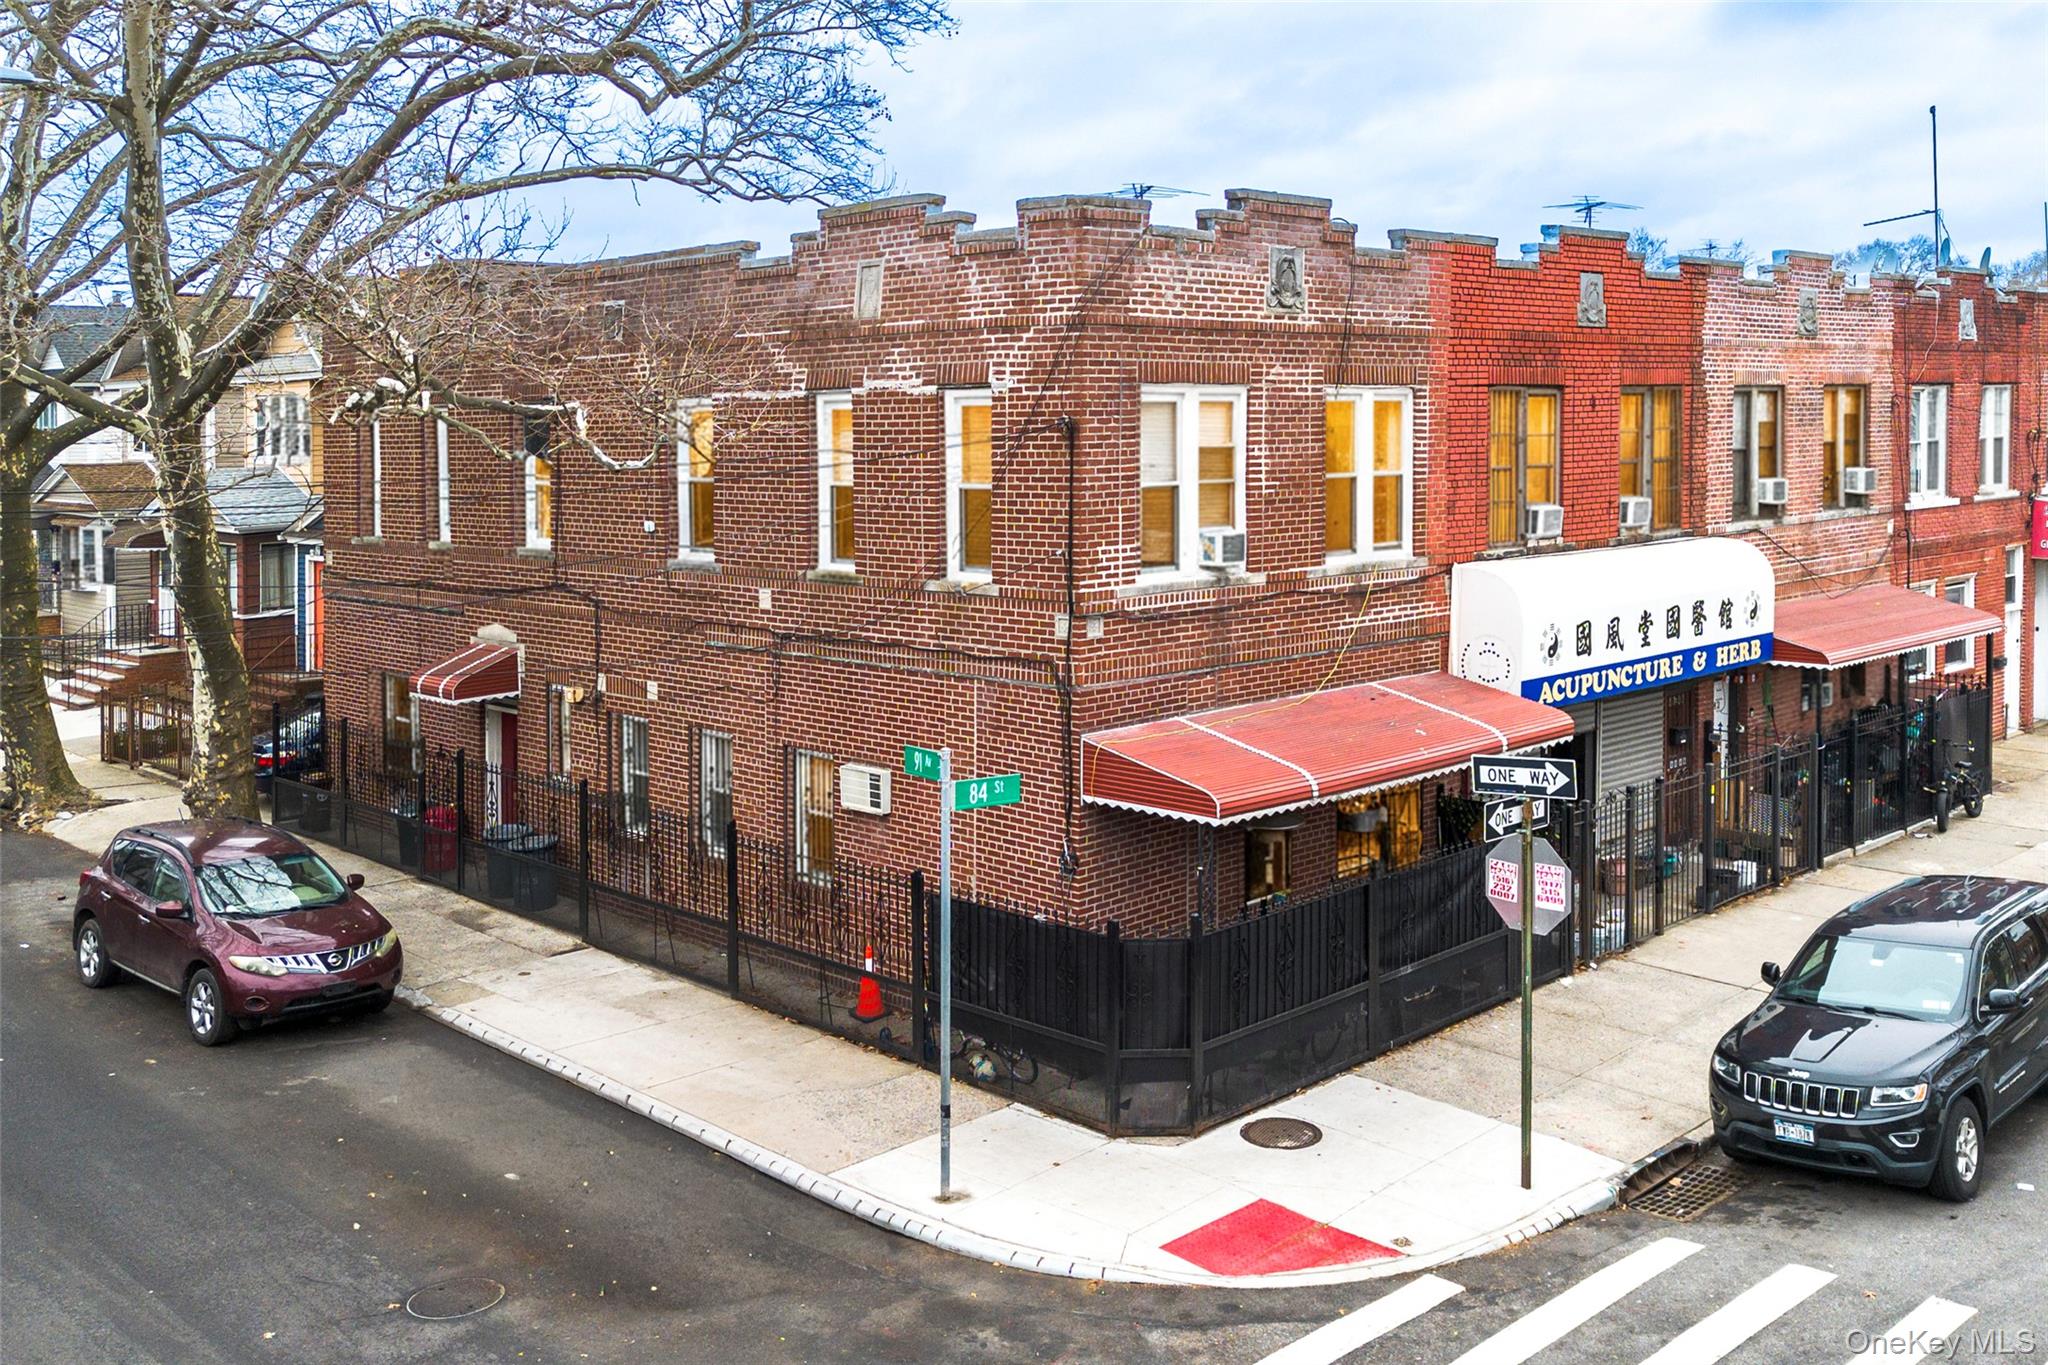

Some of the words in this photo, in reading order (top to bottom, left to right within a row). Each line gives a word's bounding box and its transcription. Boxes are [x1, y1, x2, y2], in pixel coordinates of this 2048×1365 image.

[1576, 598, 1734, 656] 國風堂國醫館
[1539, 655, 1683, 704] ACUPUNCTURE
[1693, 651, 1707, 671] &
[1716, 639, 1762, 667] HERB
[914, 751, 922, 772] 91
[1488, 768, 1516, 783] ONE
[1530, 770, 1559, 786] WAY
[969, 782, 988, 804] 84
[994, 780, 1005, 794] St
[1495, 809, 1513, 827] ONE
[1788, 1068, 1811, 1080] Jeep
